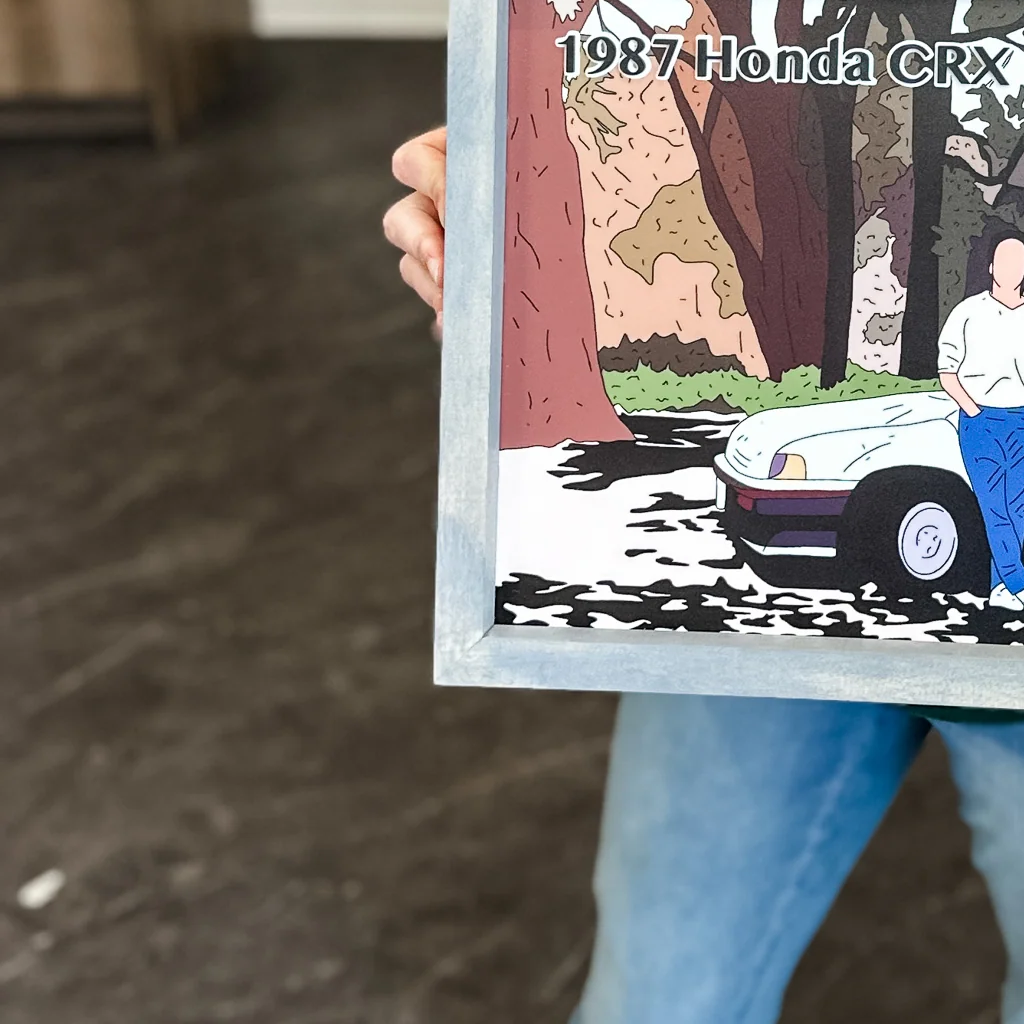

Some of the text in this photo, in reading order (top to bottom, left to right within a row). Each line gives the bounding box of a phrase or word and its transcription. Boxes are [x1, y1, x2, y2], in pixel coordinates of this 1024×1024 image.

[557, 33, 1010, 87] 1987 Honda CRX
